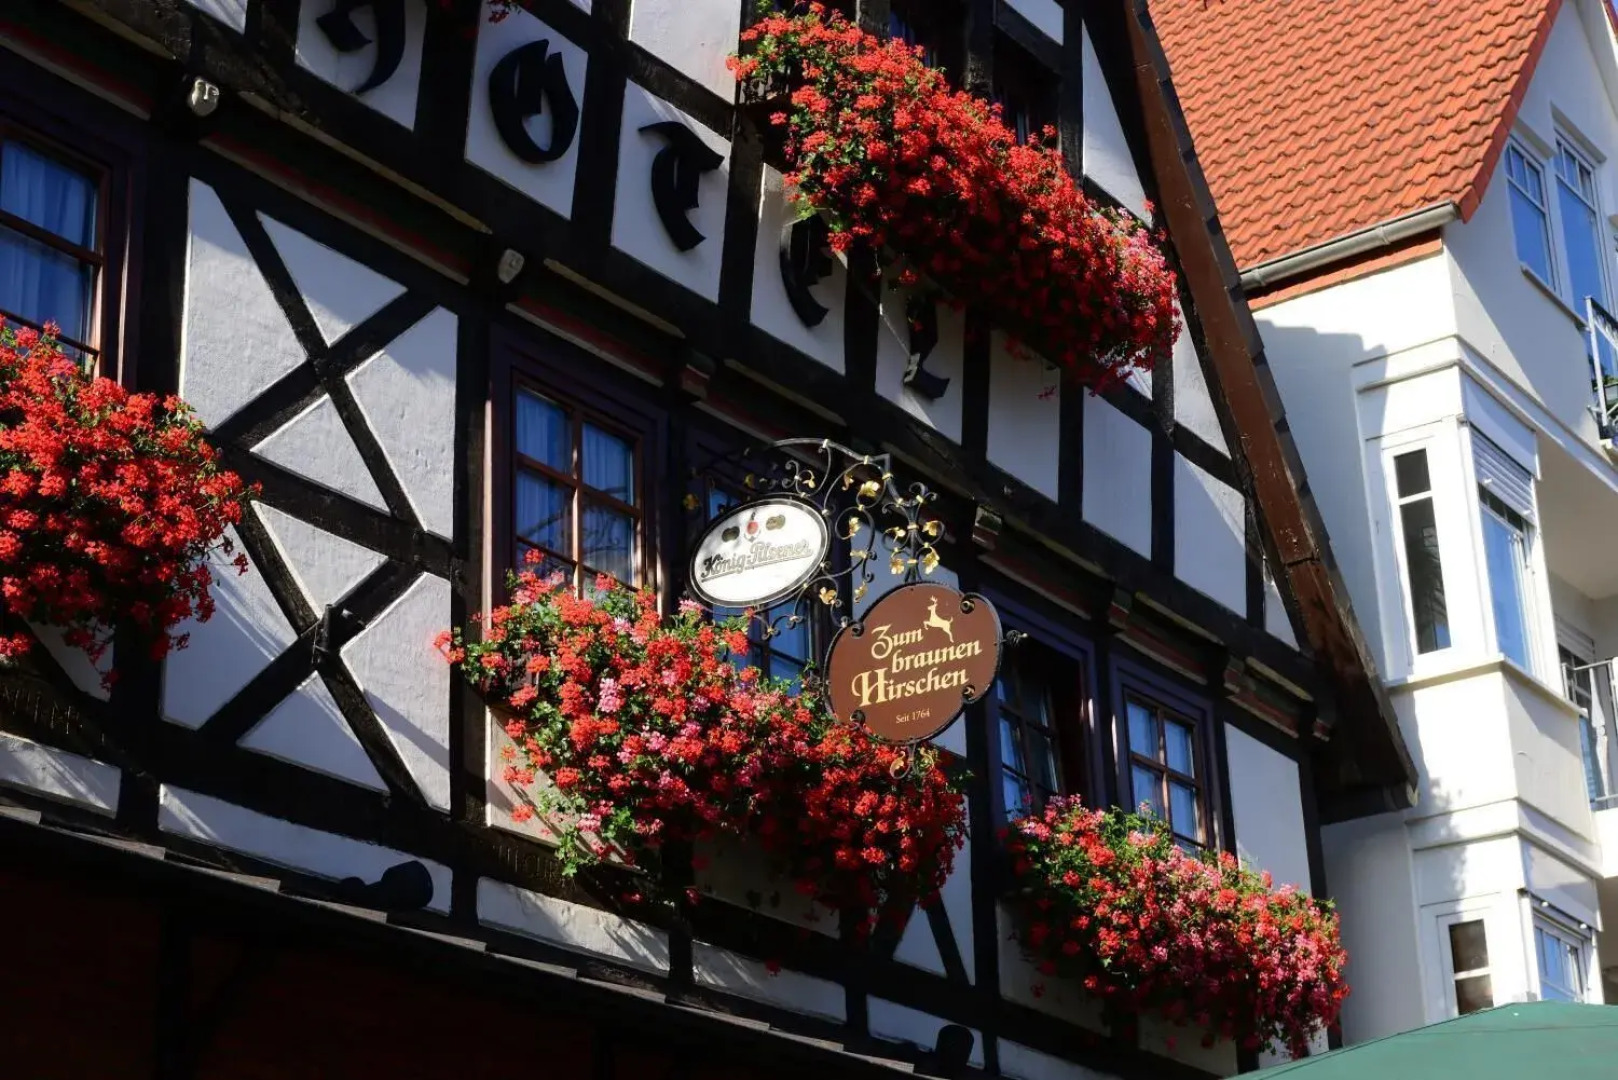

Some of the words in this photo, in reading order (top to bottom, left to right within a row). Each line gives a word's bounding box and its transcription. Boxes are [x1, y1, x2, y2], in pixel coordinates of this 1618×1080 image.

[871, 624, 924, 660] Zum
[891, 639, 983, 674] braunen
[851, 668, 969, 707] Hirschen
[895, 714, 910, 724] Seit
[912, 708, 931, 723] 1764
